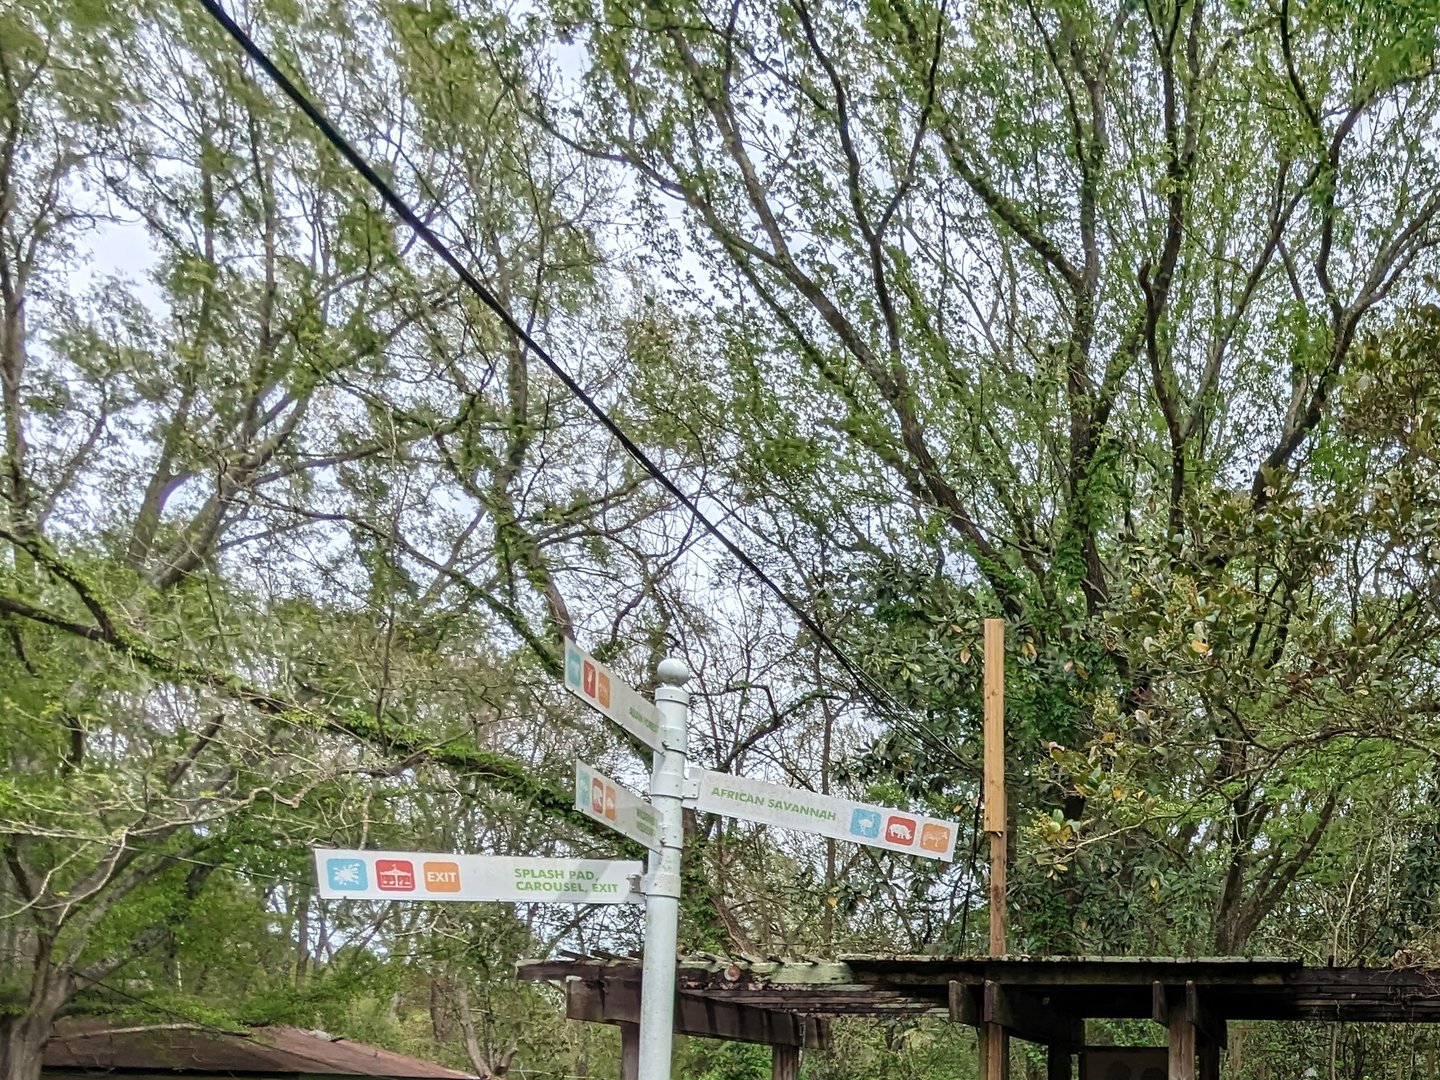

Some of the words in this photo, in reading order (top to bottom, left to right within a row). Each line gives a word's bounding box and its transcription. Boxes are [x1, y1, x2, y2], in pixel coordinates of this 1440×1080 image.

[711, 787, 765, 806] AFRICAN
[767, 799, 837, 821] SAVANNAH
[427, 871, 457, 883] EXIT
[514, 868, 565, 879] SPLASH
[569, 871, 599, 881] PAD,
[516, 881, 588, 893] CAROUSEL,
[592, 883, 618, 893] EXIT
